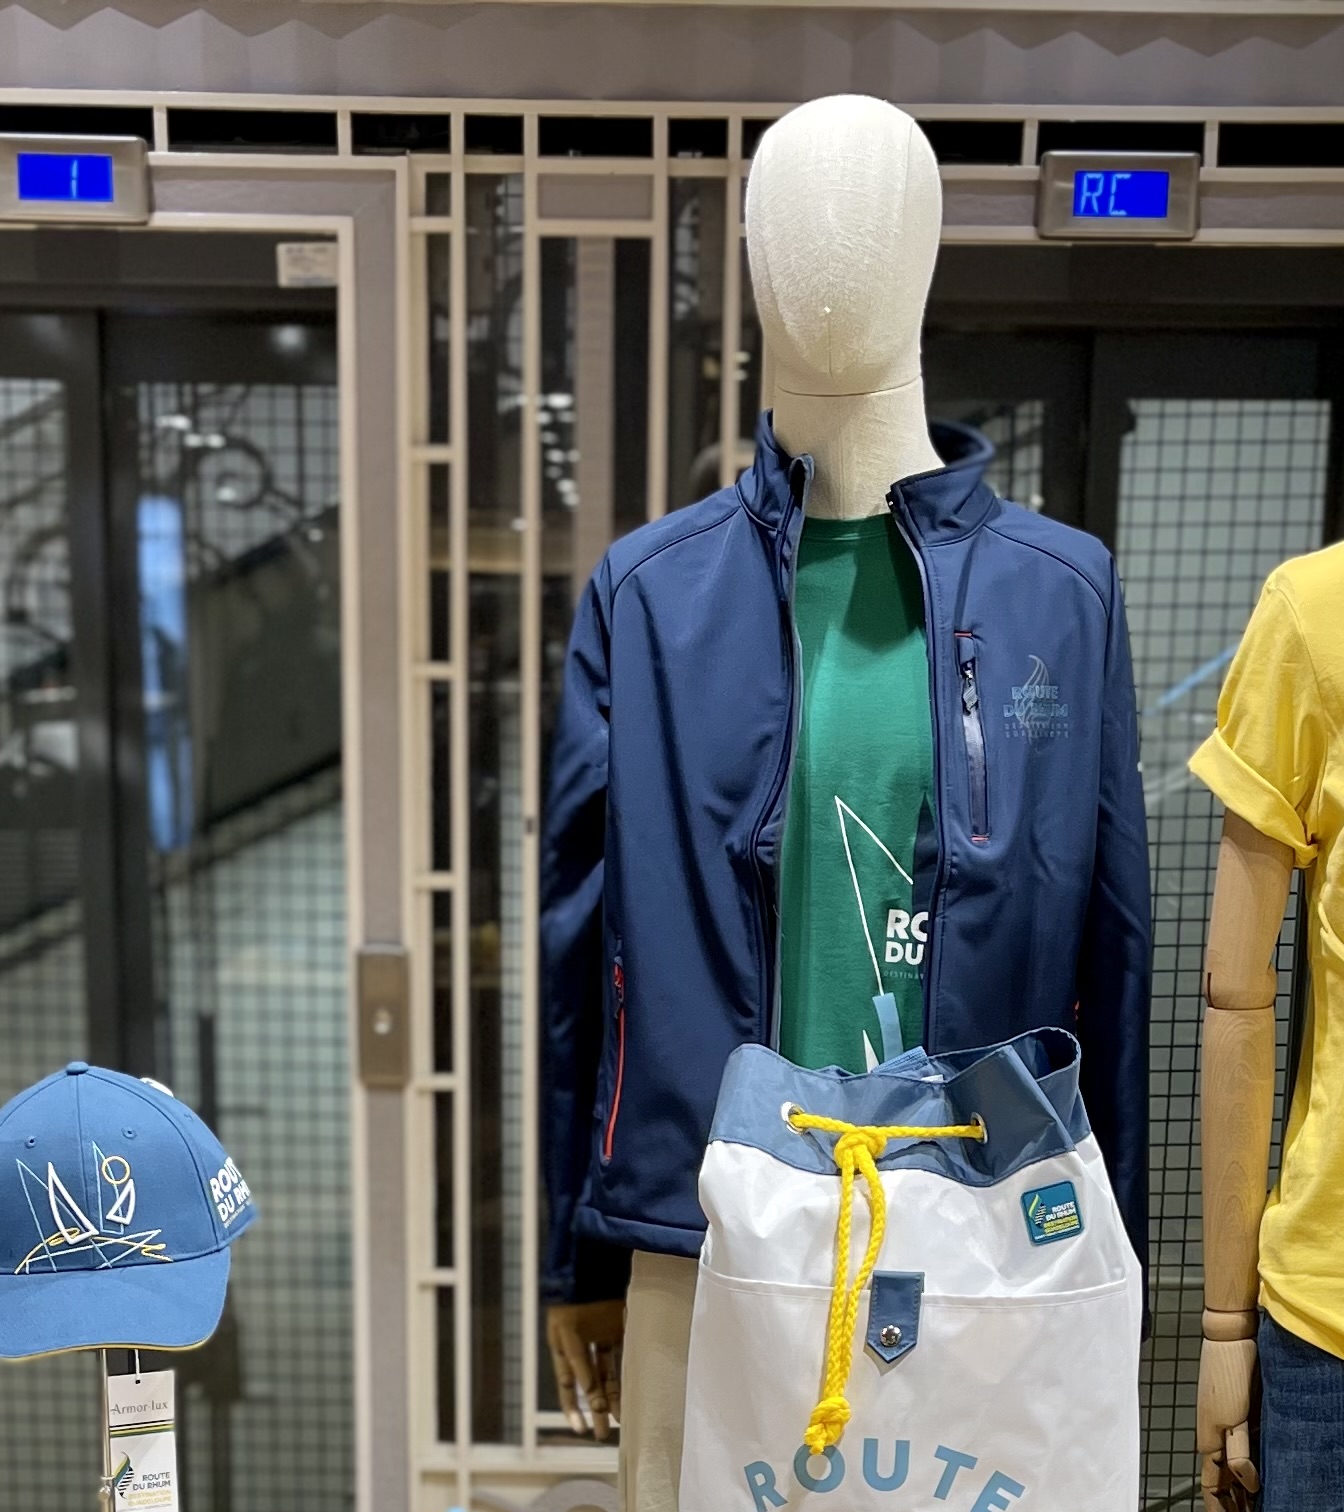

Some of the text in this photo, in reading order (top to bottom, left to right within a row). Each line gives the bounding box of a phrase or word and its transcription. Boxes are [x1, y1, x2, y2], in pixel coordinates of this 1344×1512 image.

[70, 159, 78, 199] 1
[1080, 173, 1132, 216] RC
[885, 941, 924, 966] DU
[217, 1194, 235, 1222] DU
[132, 1483, 145, 1491] DU
[142, 1472, 171, 1481] ROUTE
